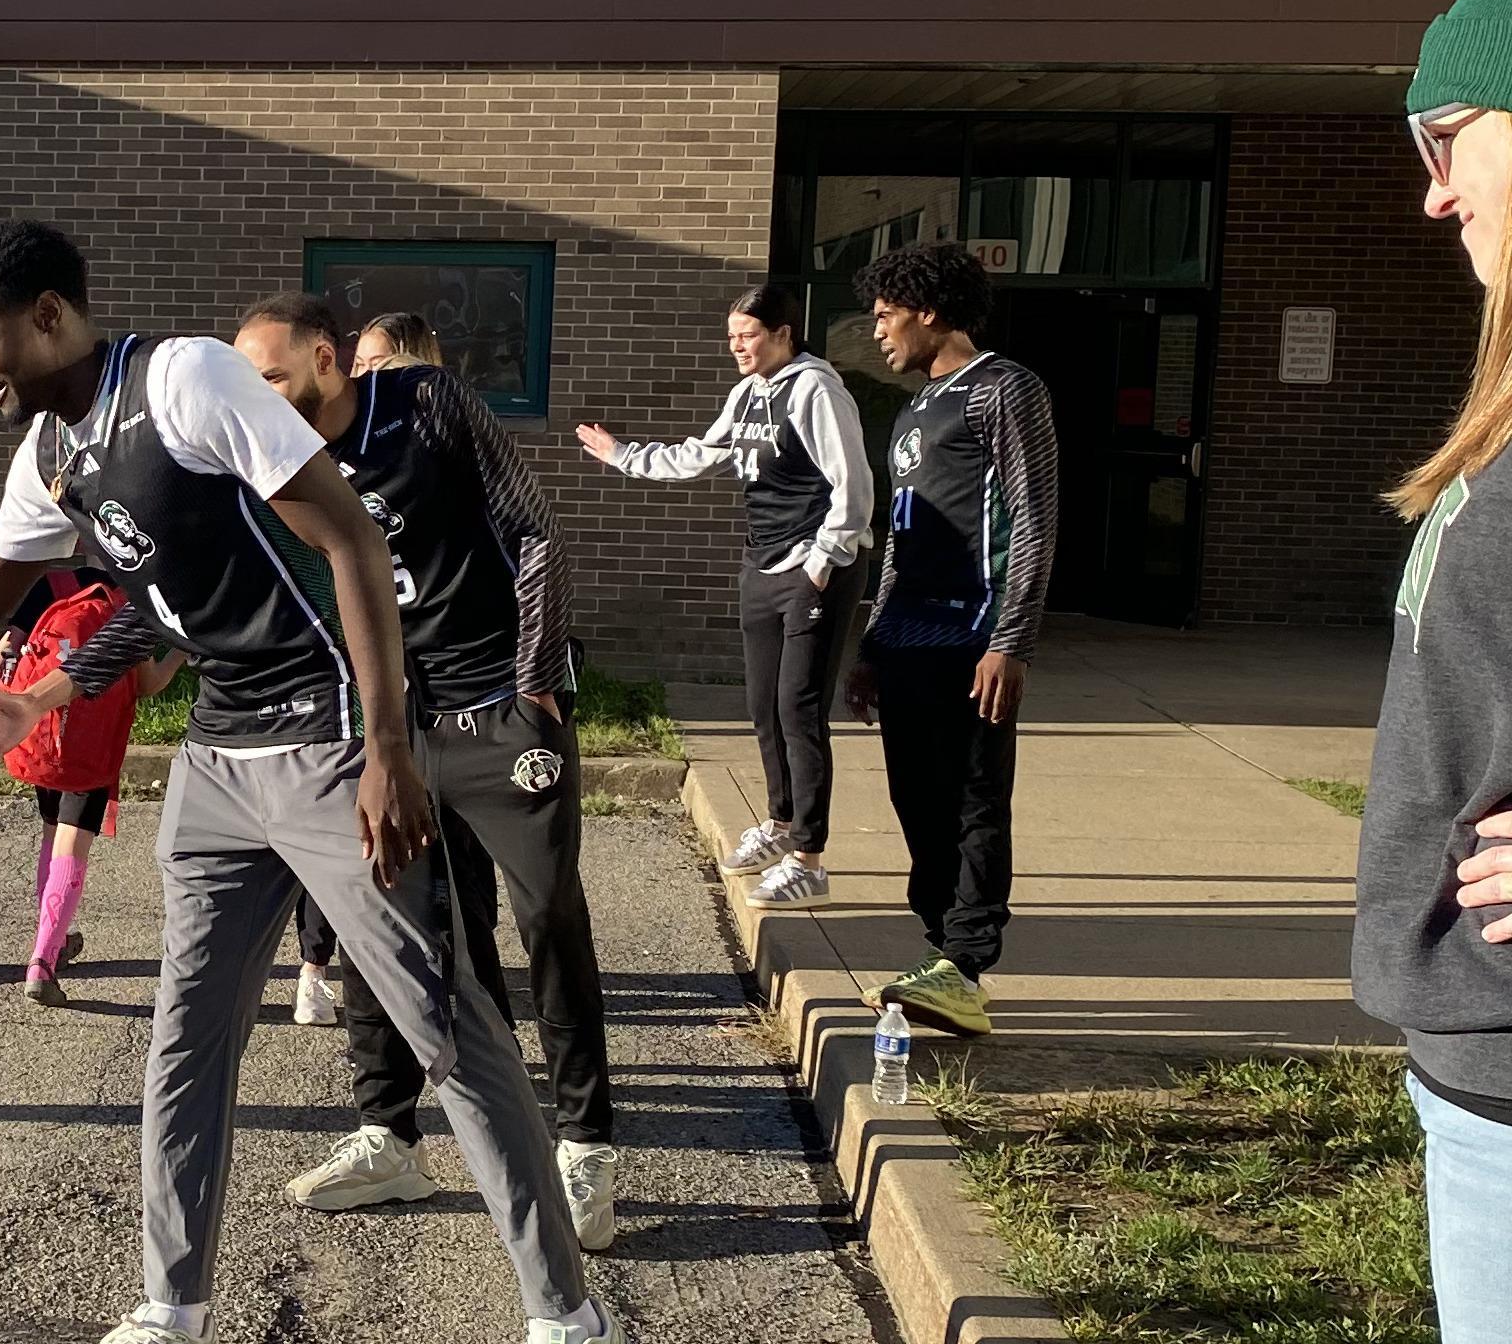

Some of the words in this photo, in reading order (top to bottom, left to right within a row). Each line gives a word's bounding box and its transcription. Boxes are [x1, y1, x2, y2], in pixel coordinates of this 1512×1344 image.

[976, 246, 1007, 267] 10
[733, 446, 760, 482] 34
[893, 485, 914, 531] 21
[147, 583, 189, 640] 4
